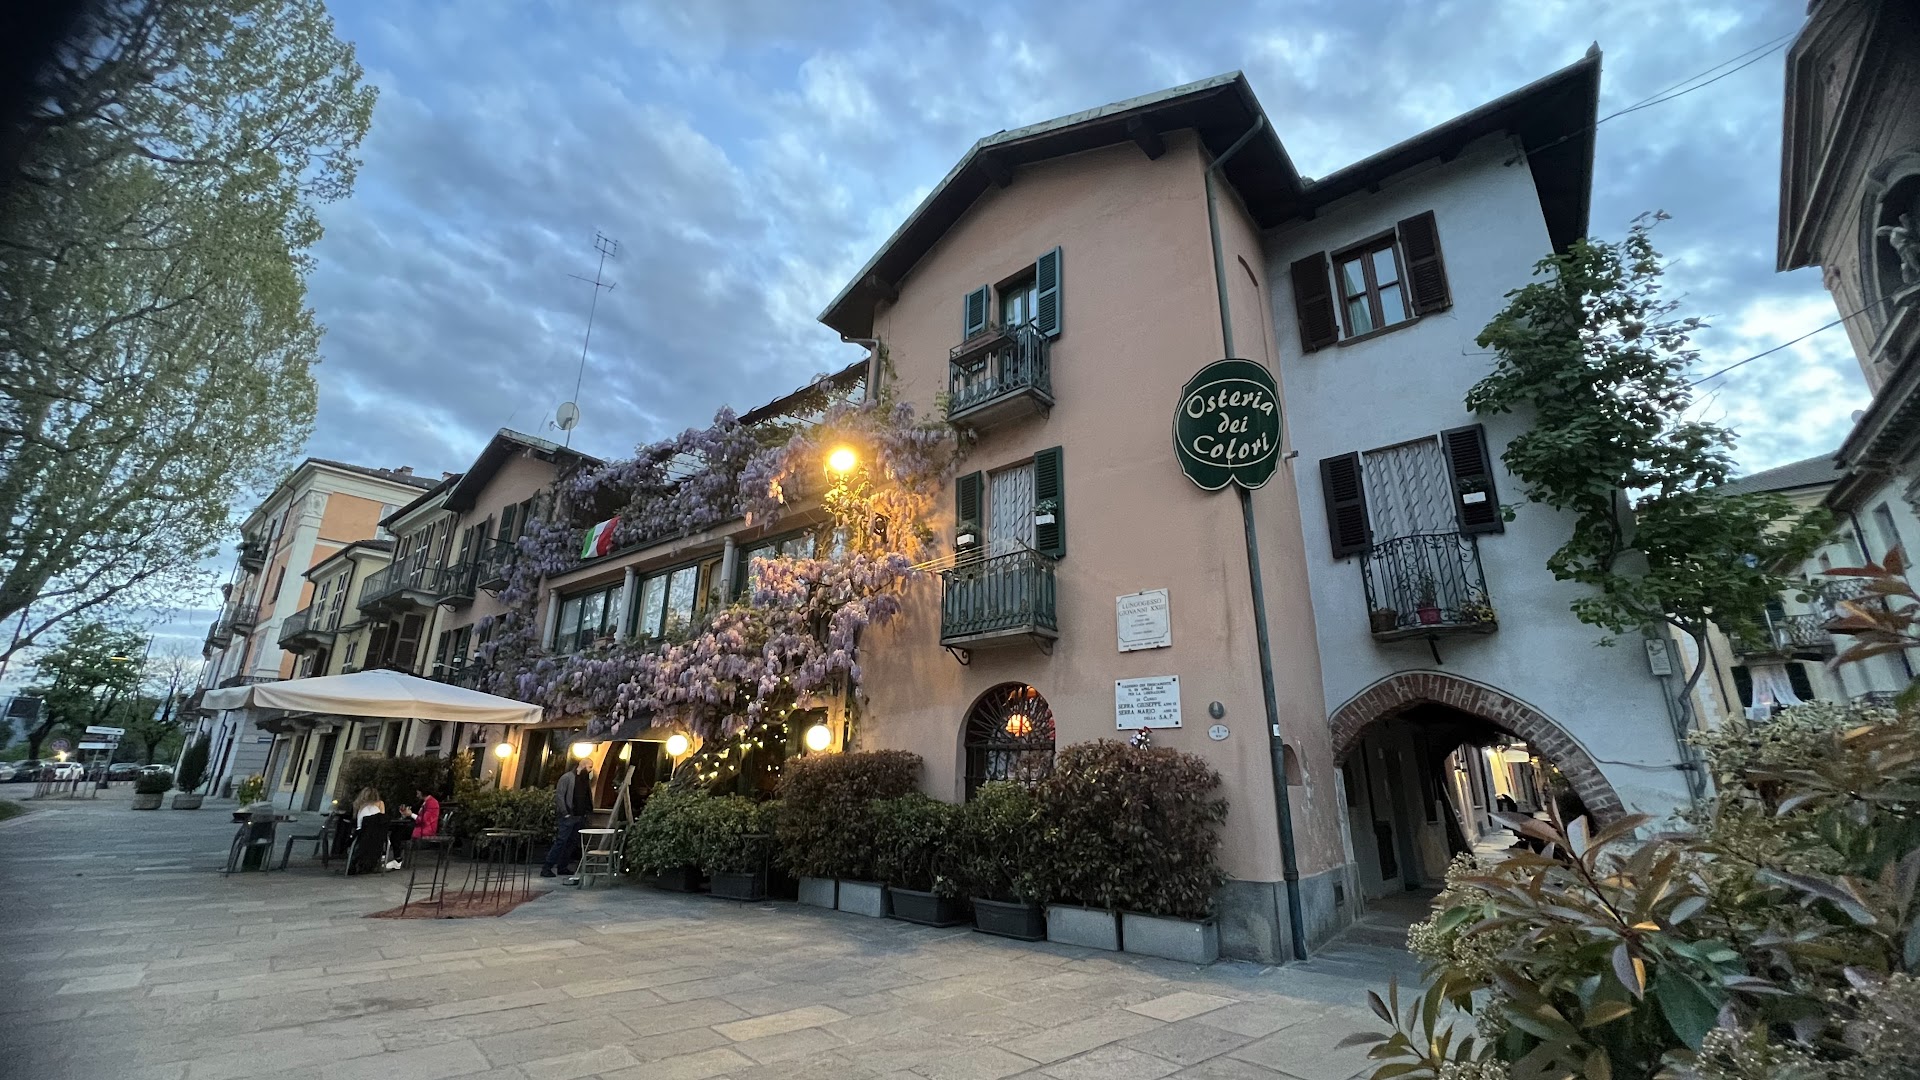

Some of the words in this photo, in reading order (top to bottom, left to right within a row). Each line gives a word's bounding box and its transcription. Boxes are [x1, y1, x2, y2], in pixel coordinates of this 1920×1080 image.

[1186, 388, 1274, 419] Osteria
[1217, 412, 1248, 434] dei
[1193, 431, 1270, 460] Colori
[1119, 607, 1148, 617] GIOVANNI
[1122, 598, 1162, 609] LUNGOGESSO
